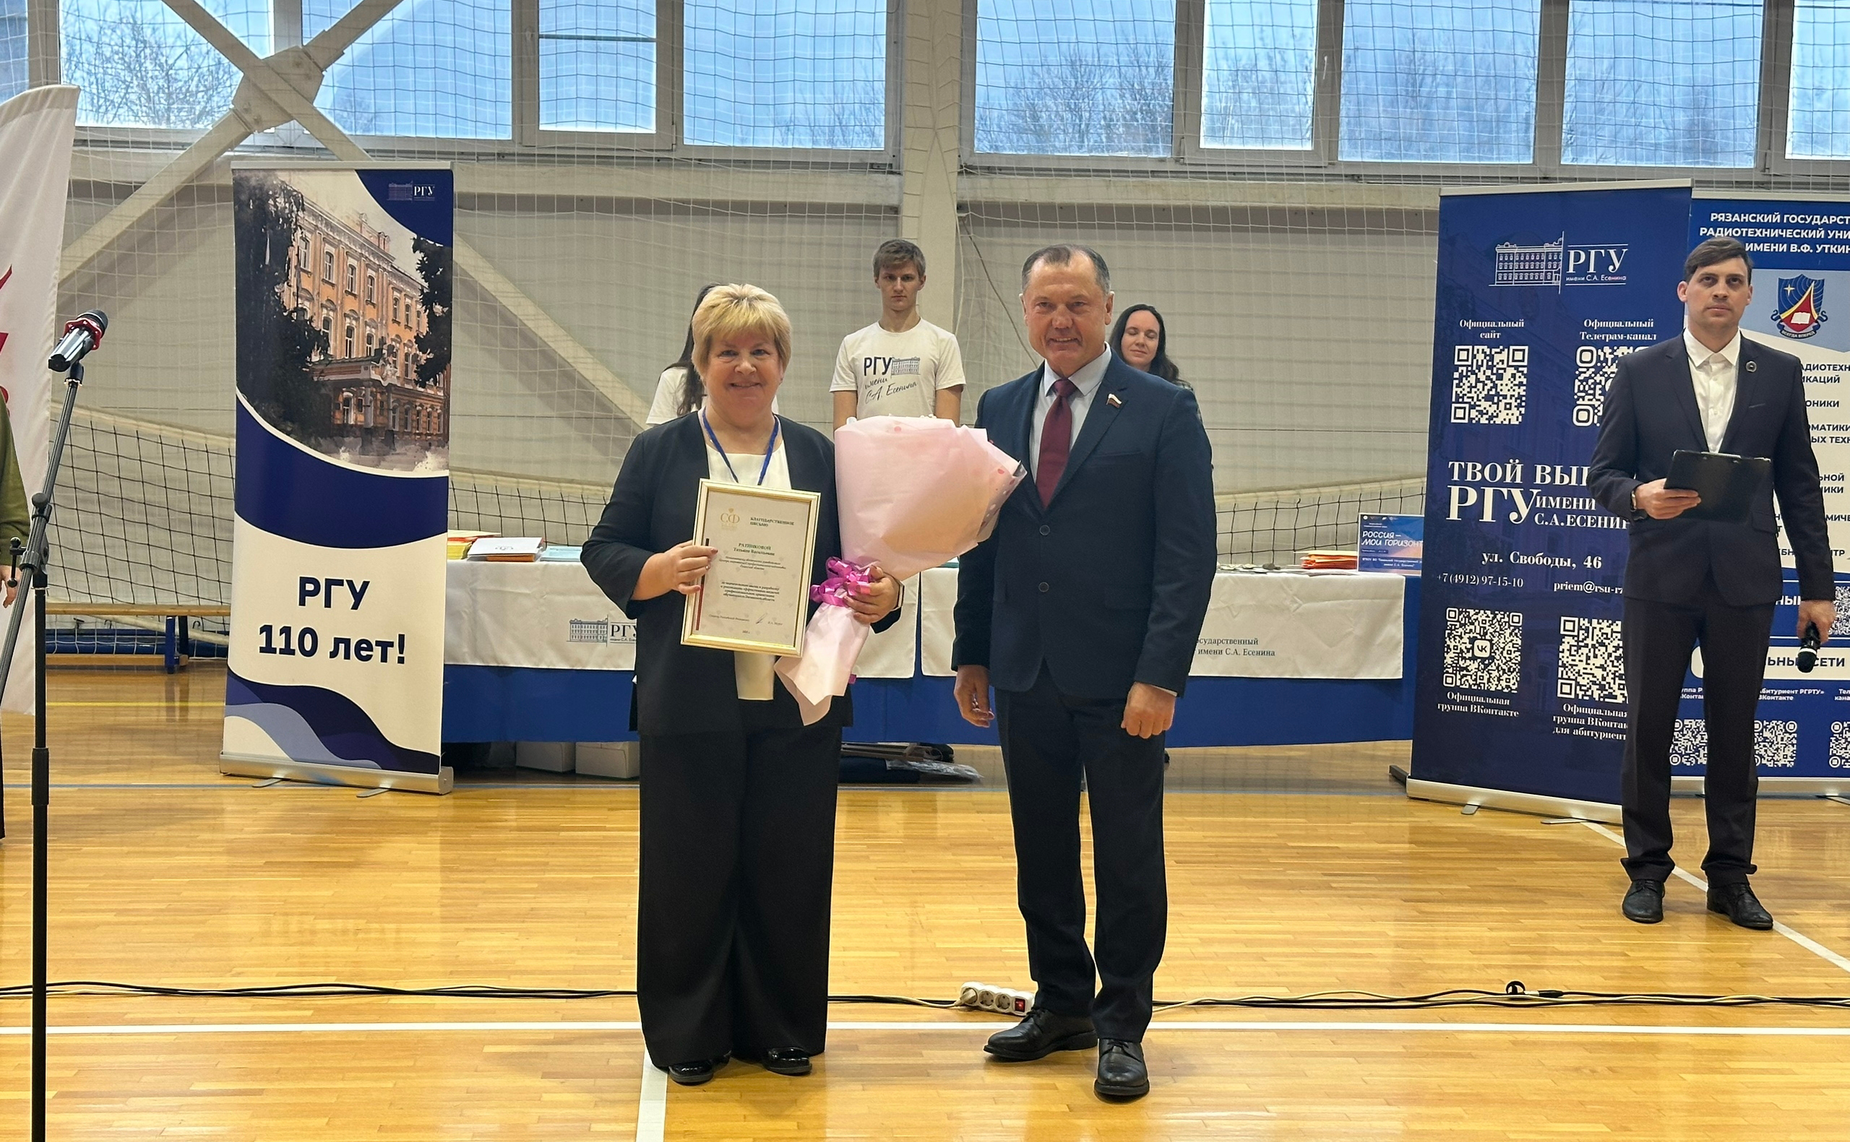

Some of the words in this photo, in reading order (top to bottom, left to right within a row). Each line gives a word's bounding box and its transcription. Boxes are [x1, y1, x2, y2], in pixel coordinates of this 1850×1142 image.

[414, 186, 436, 196] РГУ
[1710, 212, 1781, 223] РЯЗАНСКИЙ
[1783, 214, 1850, 225] ГОСУДАРСТ
[1700, 227, 1825, 239] РАДИОТЕХНИЧЕСКИЙ
[1827, 230, 1850, 239] УНИ
[1745, 243, 1787, 252] ИМЕНИ
[1789, 243, 1813, 253] В.Ф.
[1566, 248, 1629, 273] РГУ
[1459, 319, 1525, 329] Официальный
[1583, 318, 1654, 329] Официальный
[1480, 331, 1502, 339] сайт
[1579, 331, 1657, 342] Телеграм-канал
[864, 356, 893, 376] РГУ
[1809, 424, 1850, 432] МАТИКИ
[1448, 458, 1524, 484] ТВОЙ
[1822, 486, 1844, 494] ИКИ
[1446, 485, 1542, 525] РГУ
[1535, 496, 1597, 511] ИМЕНИ
[1362, 530, 1395, 539] РОССИЯ
[1481, 552, 1503, 565] ул.
[1509, 551, 1577, 570] Свободы,
[1583, 555, 1602, 569] 46
[298, 576, 371, 611] РГУ
[259, 624, 319, 658] 110
[329, 633, 406, 665] лет!
[1198, 637, 1259, 646] сударственный
[1225, 648, 1241, 656] С.А.
[1243, 648, 1276, 657] Есенина
[1767, 656, 1799, 667] ЬНЫ
[1447, 691, 1511, 706] Официальная
[1437, 702, 1468, 715] группа
[1470, 703, 1520, 718] ВКонтакте
[1552, 715, 1585, 725] группа
[1552, 727, 1570, 735] для
